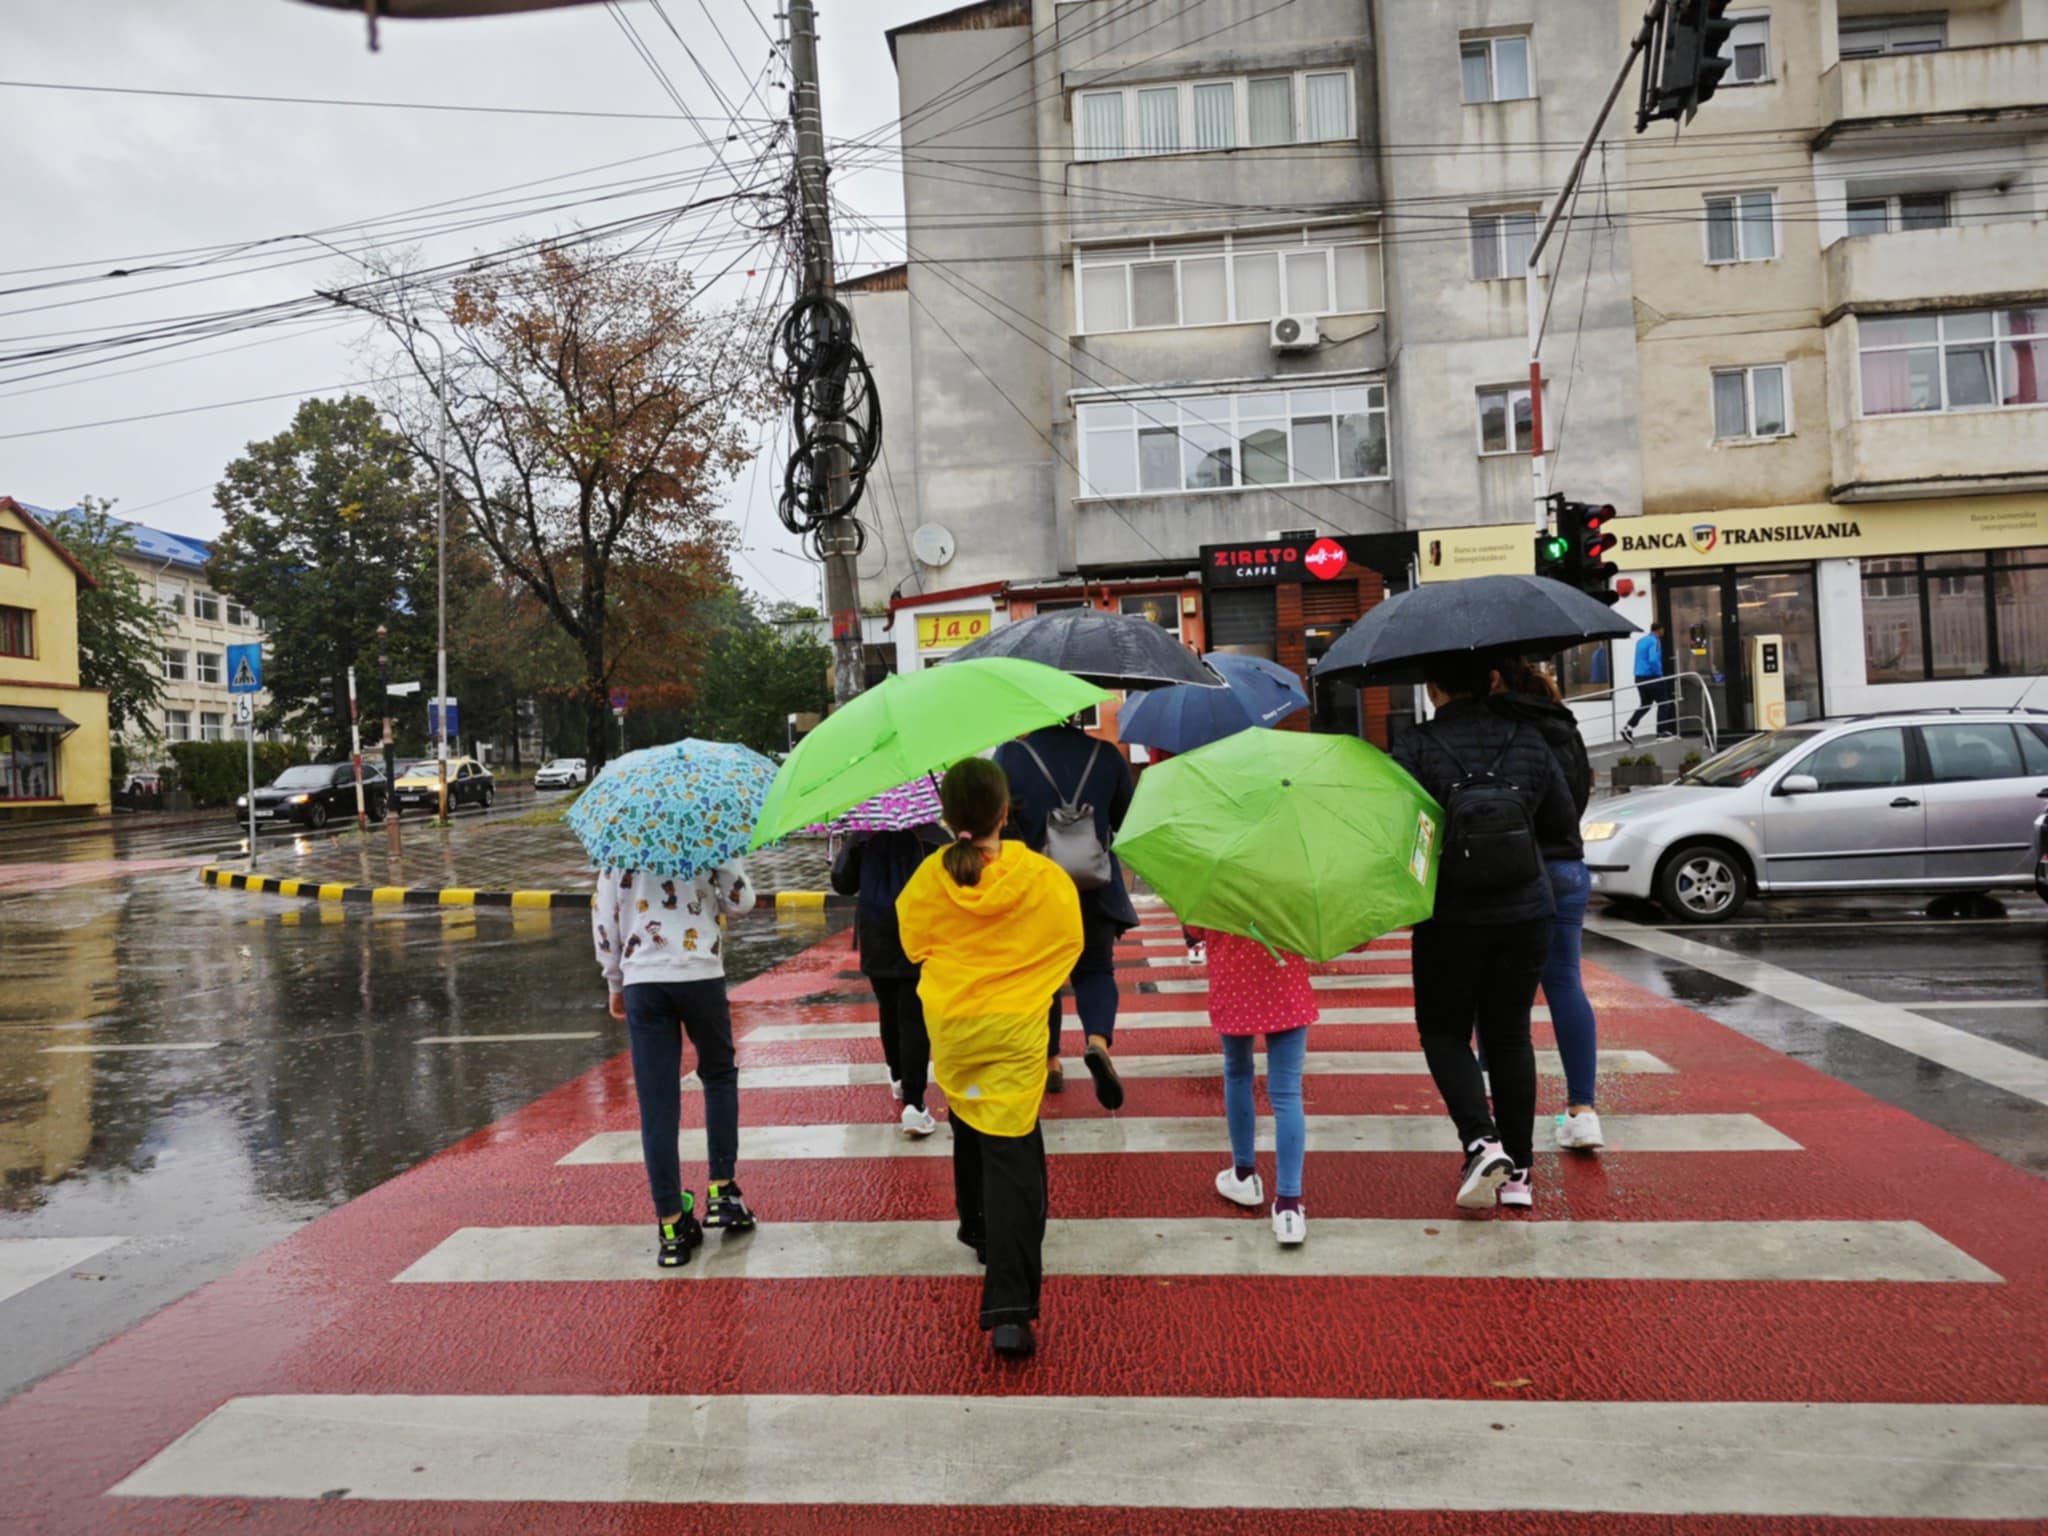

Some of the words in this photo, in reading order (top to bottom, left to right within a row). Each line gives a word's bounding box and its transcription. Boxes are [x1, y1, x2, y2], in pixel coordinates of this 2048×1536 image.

[1621, 532, 1687, 551] BANCA
[1721, 522, 1862, 545] TRANSILVANIA
[1214, 548, 1297, 566] ZIRETO
[1236, 566, 1277, 577] CAFFE
[925, 616, 982, 648] jao
